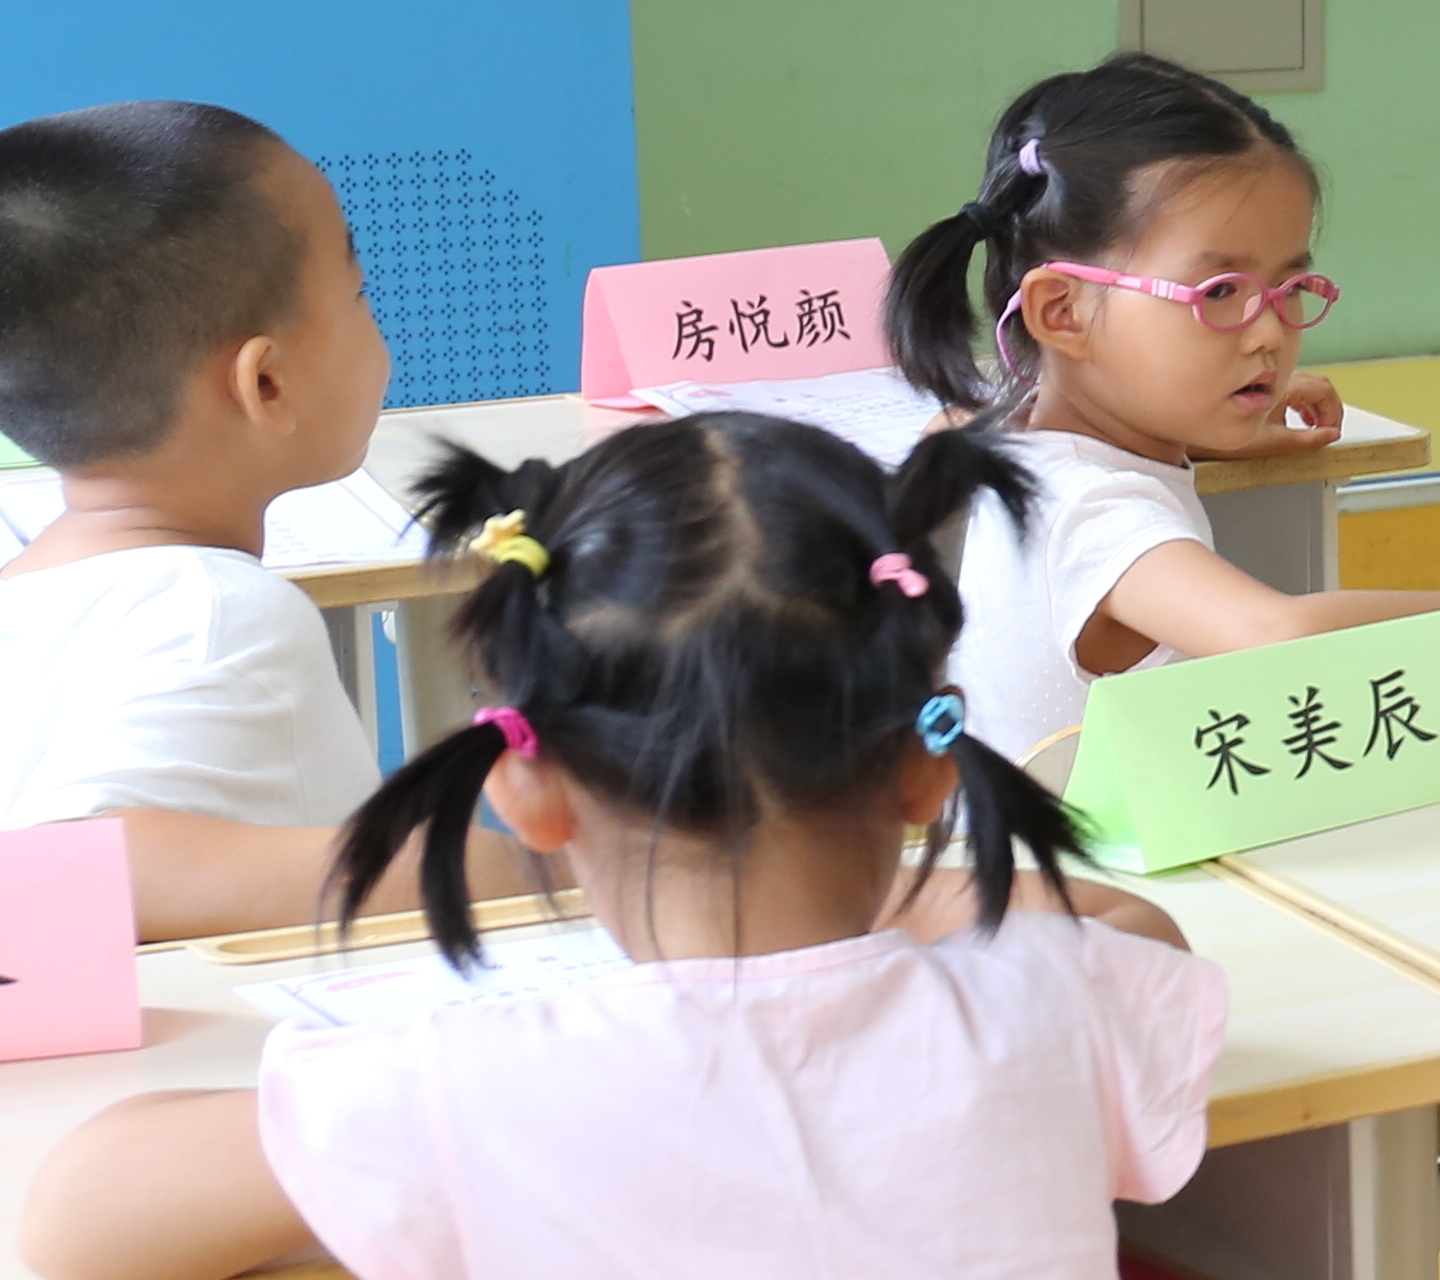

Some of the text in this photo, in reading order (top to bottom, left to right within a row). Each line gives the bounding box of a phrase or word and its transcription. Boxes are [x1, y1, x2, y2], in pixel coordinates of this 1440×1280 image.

[672, 288, 851, 362] 房悦颜
[1194, 669, 1439, 796] 宋美辰
